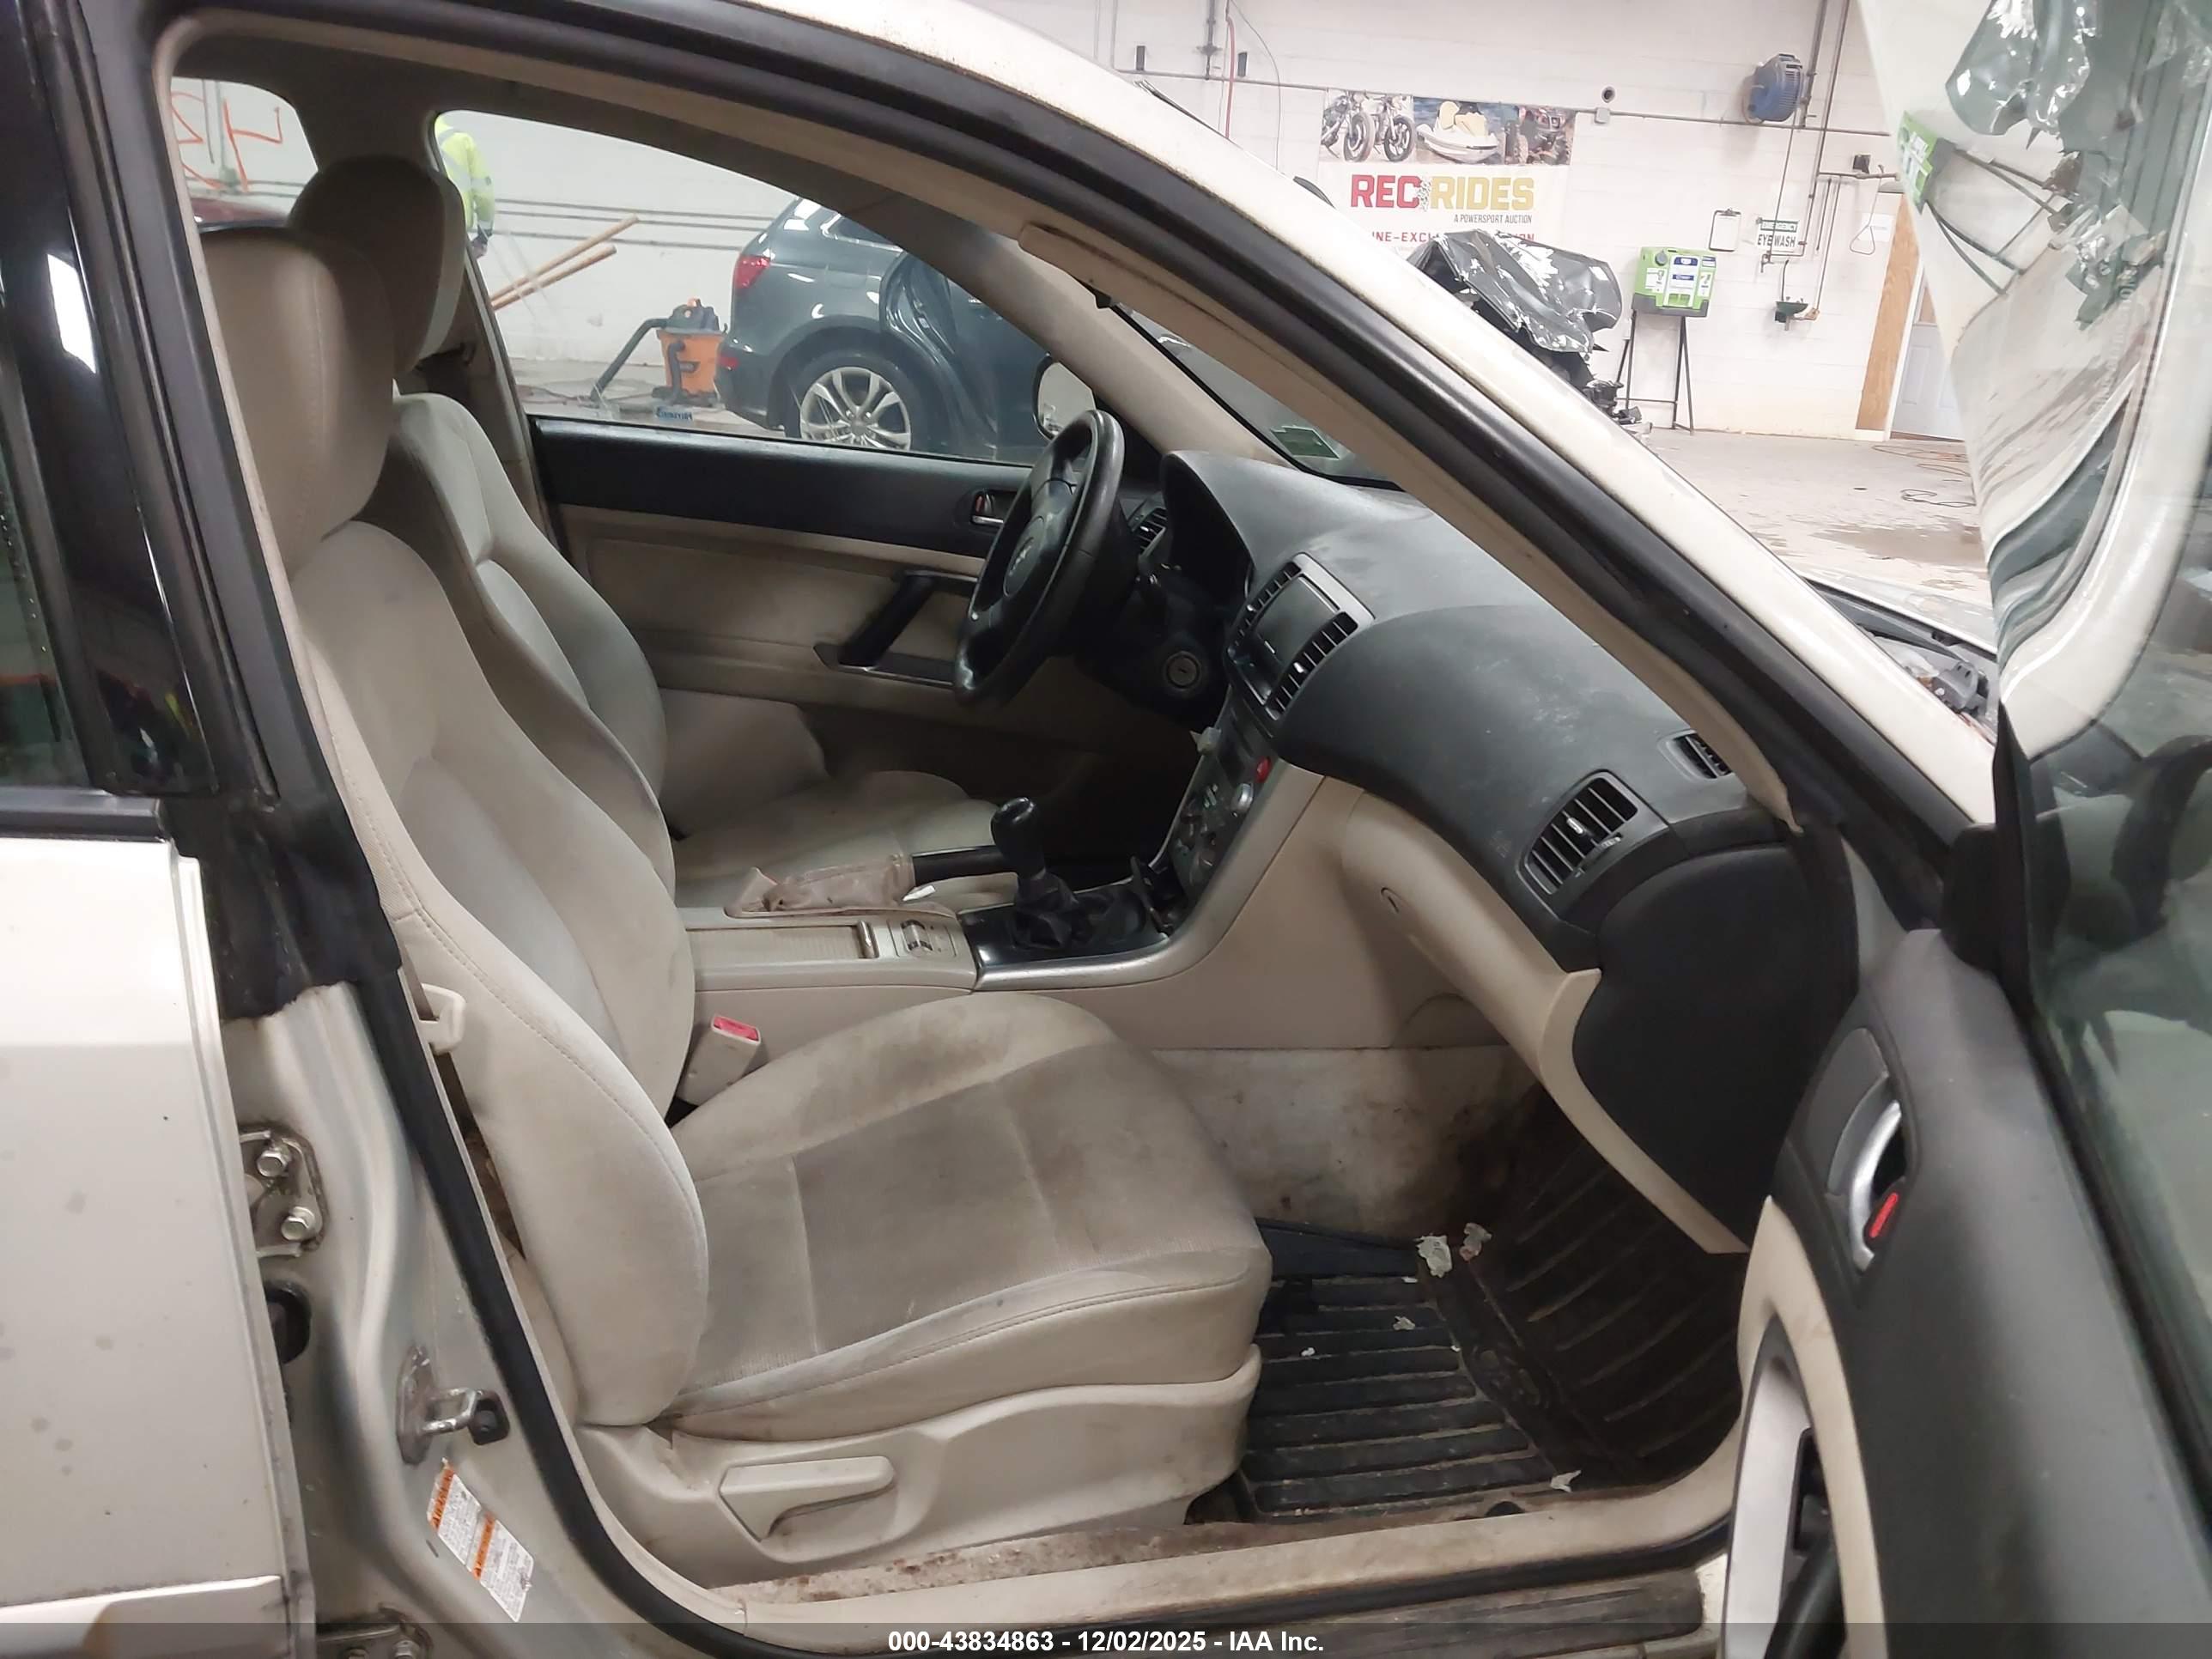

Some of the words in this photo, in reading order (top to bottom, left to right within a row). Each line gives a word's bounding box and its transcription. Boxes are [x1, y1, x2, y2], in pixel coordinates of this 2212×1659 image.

[1351, 174, 1422, 209] REC
[1430, 176, 1534, 210] RIDES
[1454, 214, 1459, 223] A
[1461, 214, 1504, 224] POWERSPORT
[1505, 214, 1533, 224] AUCTION
[1773, 235, 1796, 248] WASH
